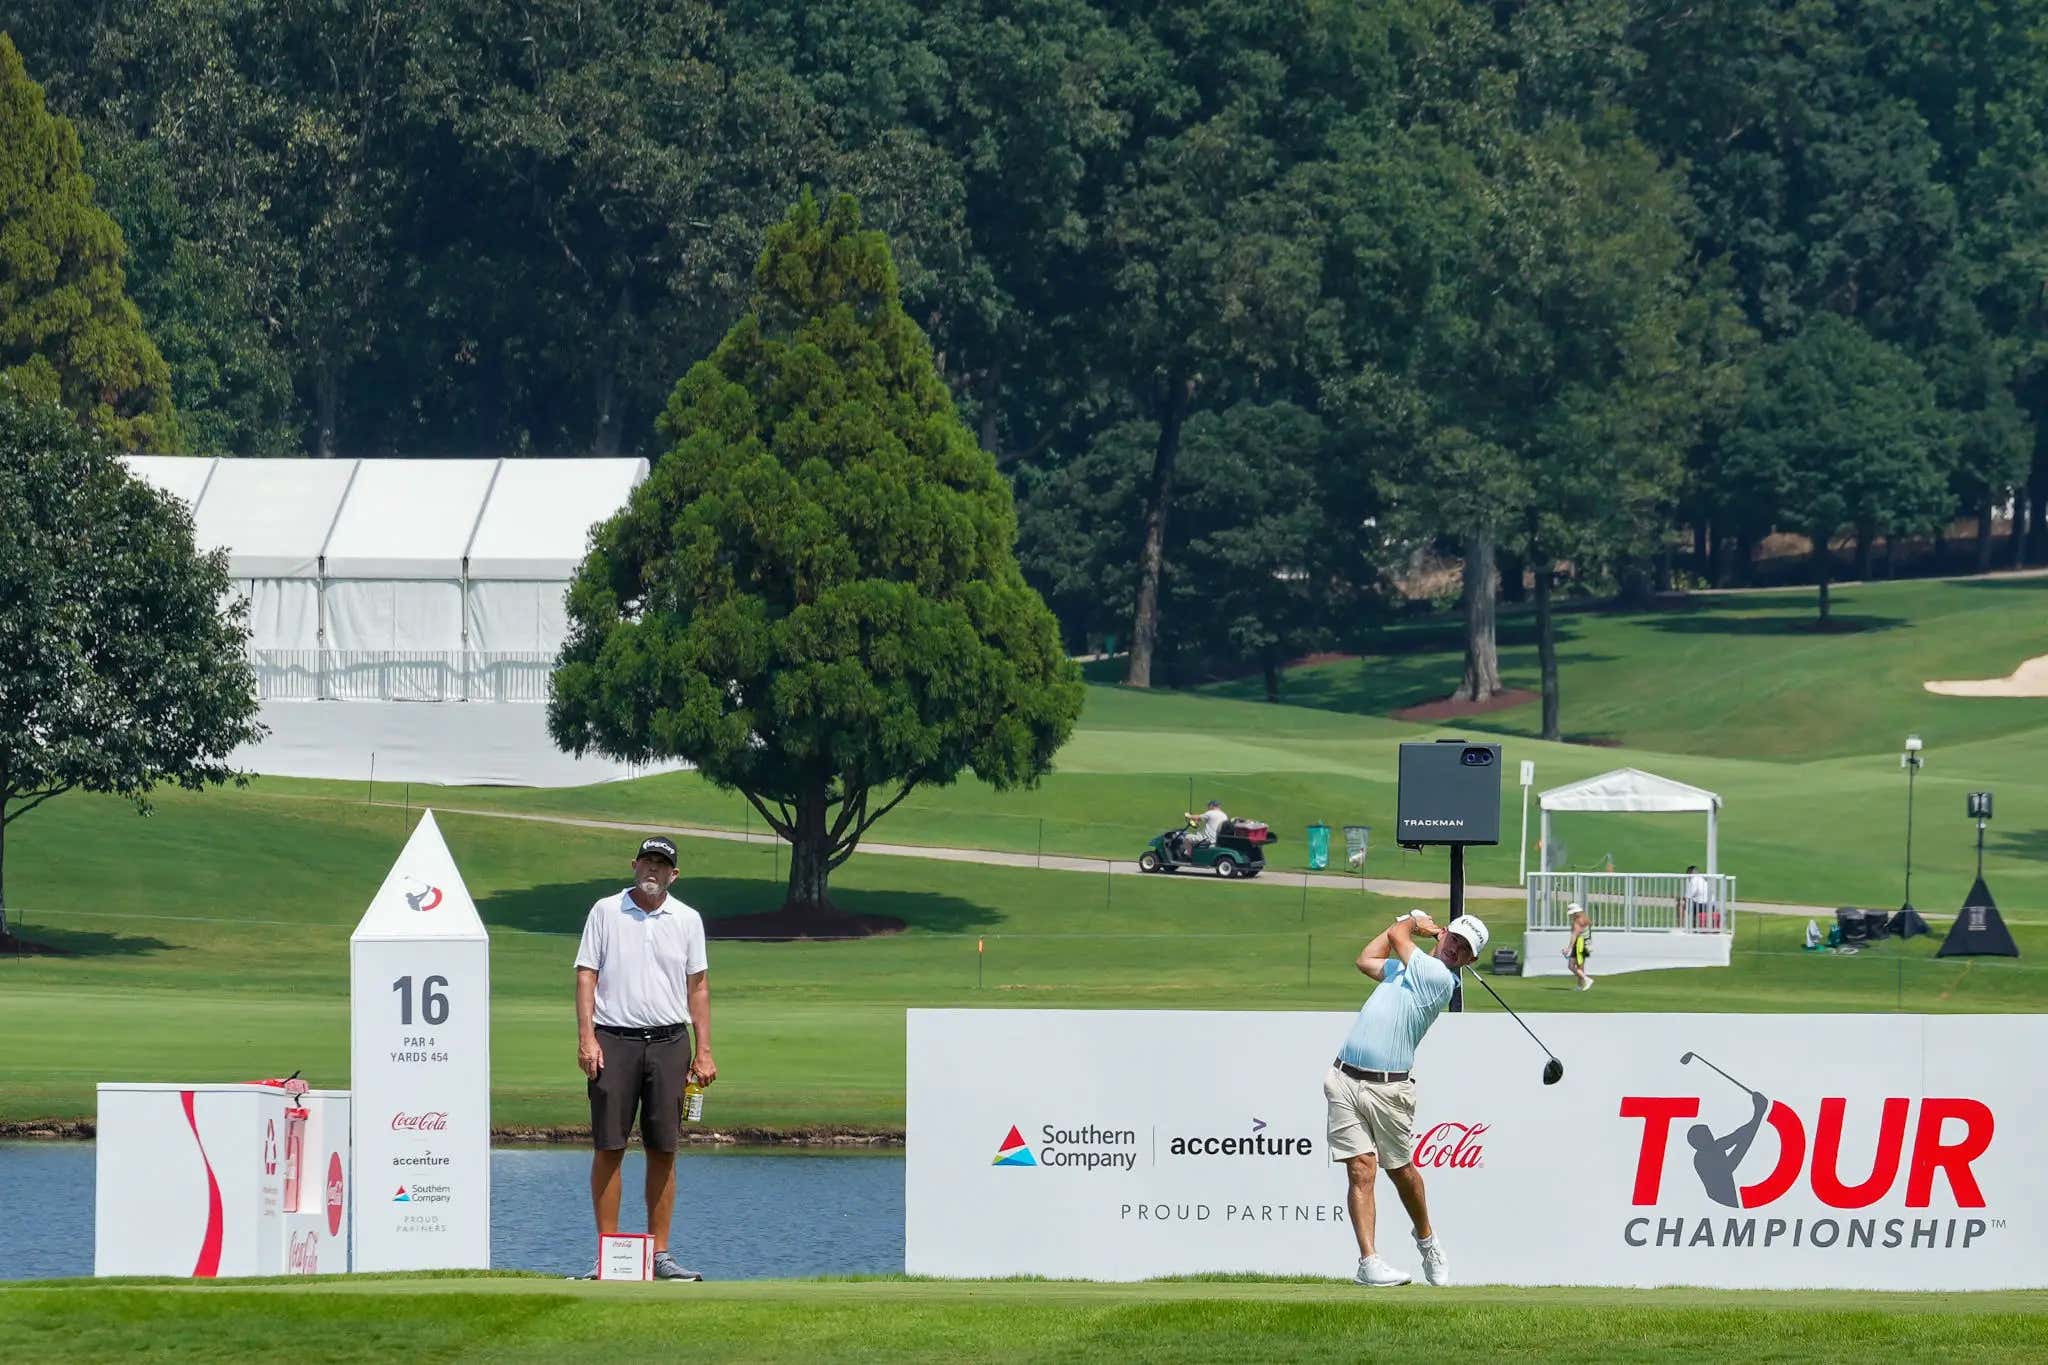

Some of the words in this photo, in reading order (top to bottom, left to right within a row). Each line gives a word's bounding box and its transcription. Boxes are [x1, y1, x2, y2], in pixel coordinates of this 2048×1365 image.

[1403, 819, 1464, 827] TRACKMAN
[392, 974, 450, 1026] 16
[403, 1037, 426, 1047] PAR
[428, 1037, 435, 1047] 4
[390, 1052, 427, 1062] YARDS
[430, 1052, 449, 1062] 454
[1042, 1124, 1135, 1145] Southern
[1170, 1130, 1313, 1156] accenture
[392, 1154, 450, 1166] accenture
[1040, 1146, 1137, 1172] Company
[1619, 1096, 1995, 1209] TOUR
[412, 1184, 451, 1193] Southern
[411, 1193, 451, 1204] Company
[1121, 1204, 1211, 1221] PROUD
[1226, 1205, 1344, 1221] PARTNER
[1624, 1217, 1987, 1249] CHAMPIONSHIP
